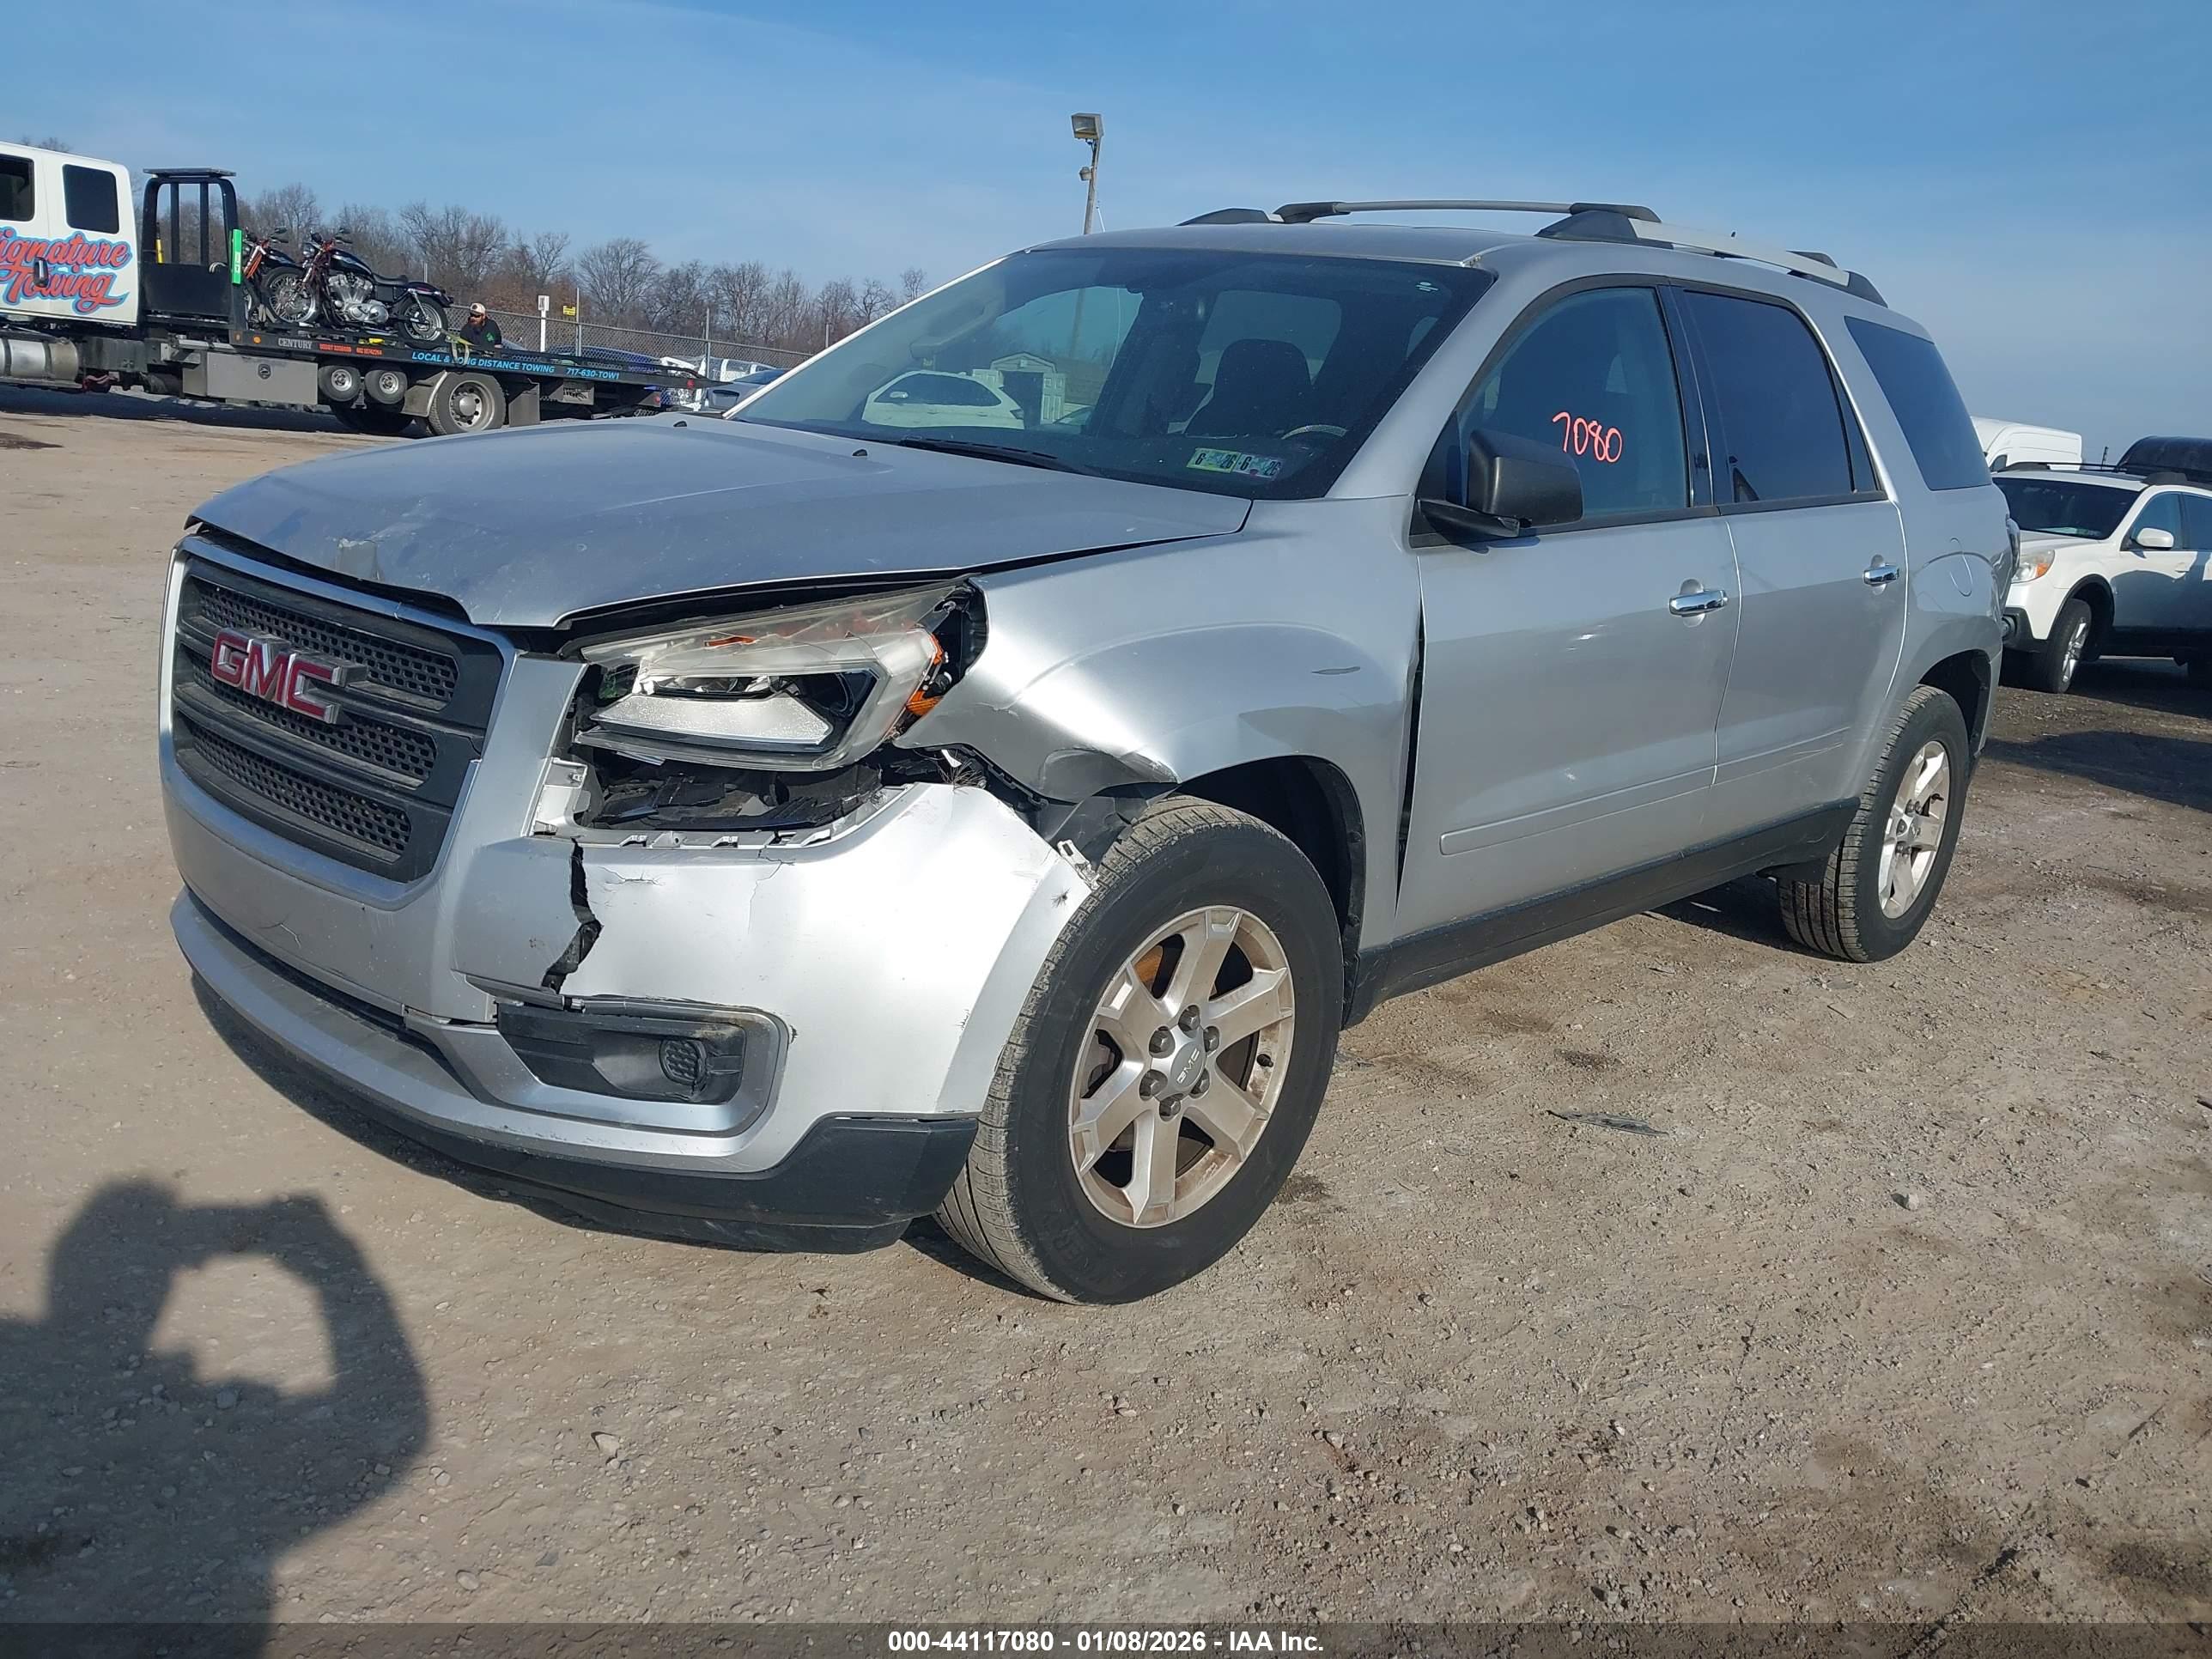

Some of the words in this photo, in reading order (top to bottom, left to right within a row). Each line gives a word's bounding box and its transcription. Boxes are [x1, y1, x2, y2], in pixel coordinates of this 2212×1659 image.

[0, 228, 131, 283] ignature
[277, 337, 313, 349] CENTURY
[412, 351, 442, 362] LOCAL
[477, 359, 520, 370] DISTANCE
[521, 363, 556, 373] TOWING
[1552, 411, 1623, 463] 7080
[1219, 454, 1237, 469] 26
[211, 628, 348, 725] GMC
[1176, 1048, 1200, 1084] GMC
